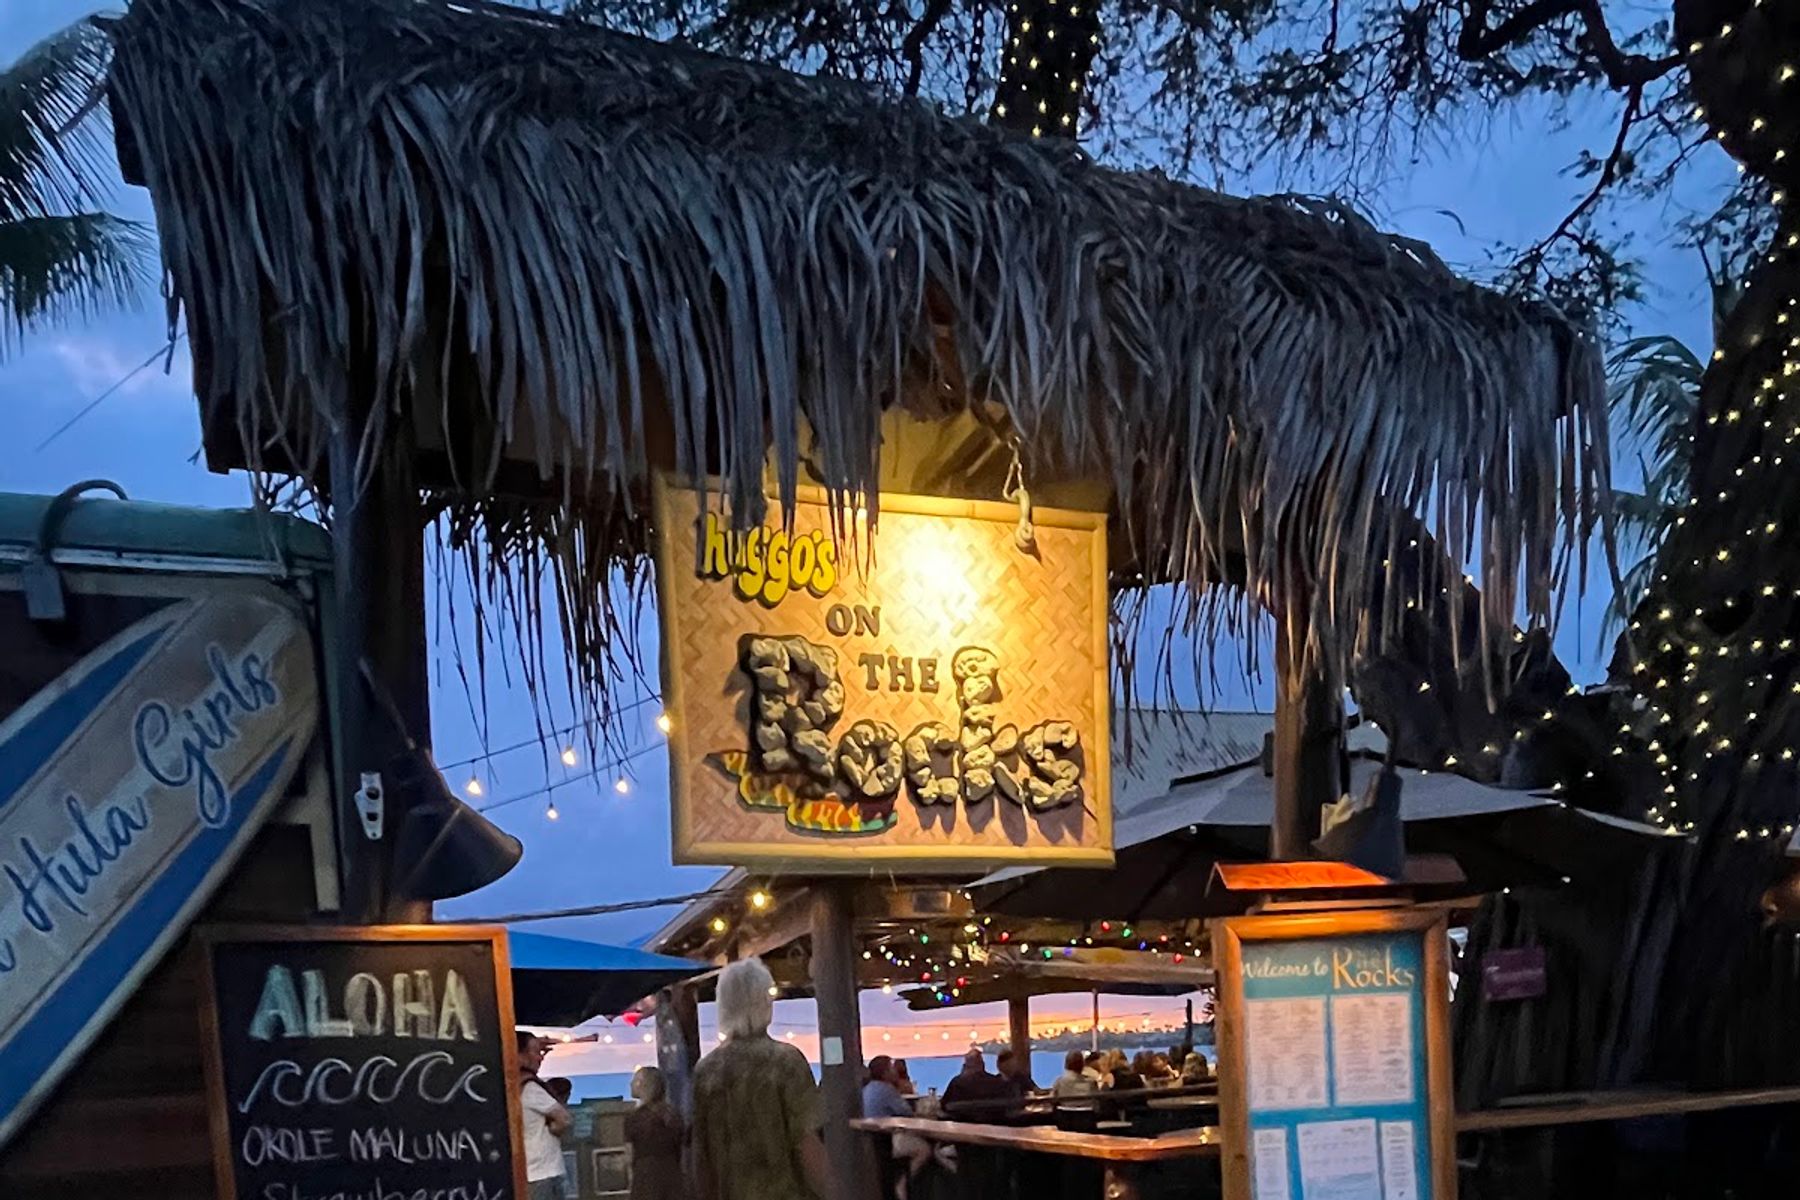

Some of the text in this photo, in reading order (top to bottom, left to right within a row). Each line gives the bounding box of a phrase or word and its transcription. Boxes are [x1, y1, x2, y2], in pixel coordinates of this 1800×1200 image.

[825, 603, 882, 637] ON
[858, 653, 939, 693] THE
[746, 634, 1080, 810] Rocks
[3, 643, 278, 934] Hula Girls
[1240, 957, 1311, 978] Welcome
[1313, 956, 1330, 976] to
[1332, 945, 1415, 990] Rocks
[249, 964, 482, 1042] ALOHA
[242, 1125, 339, 1166] OKOLE
